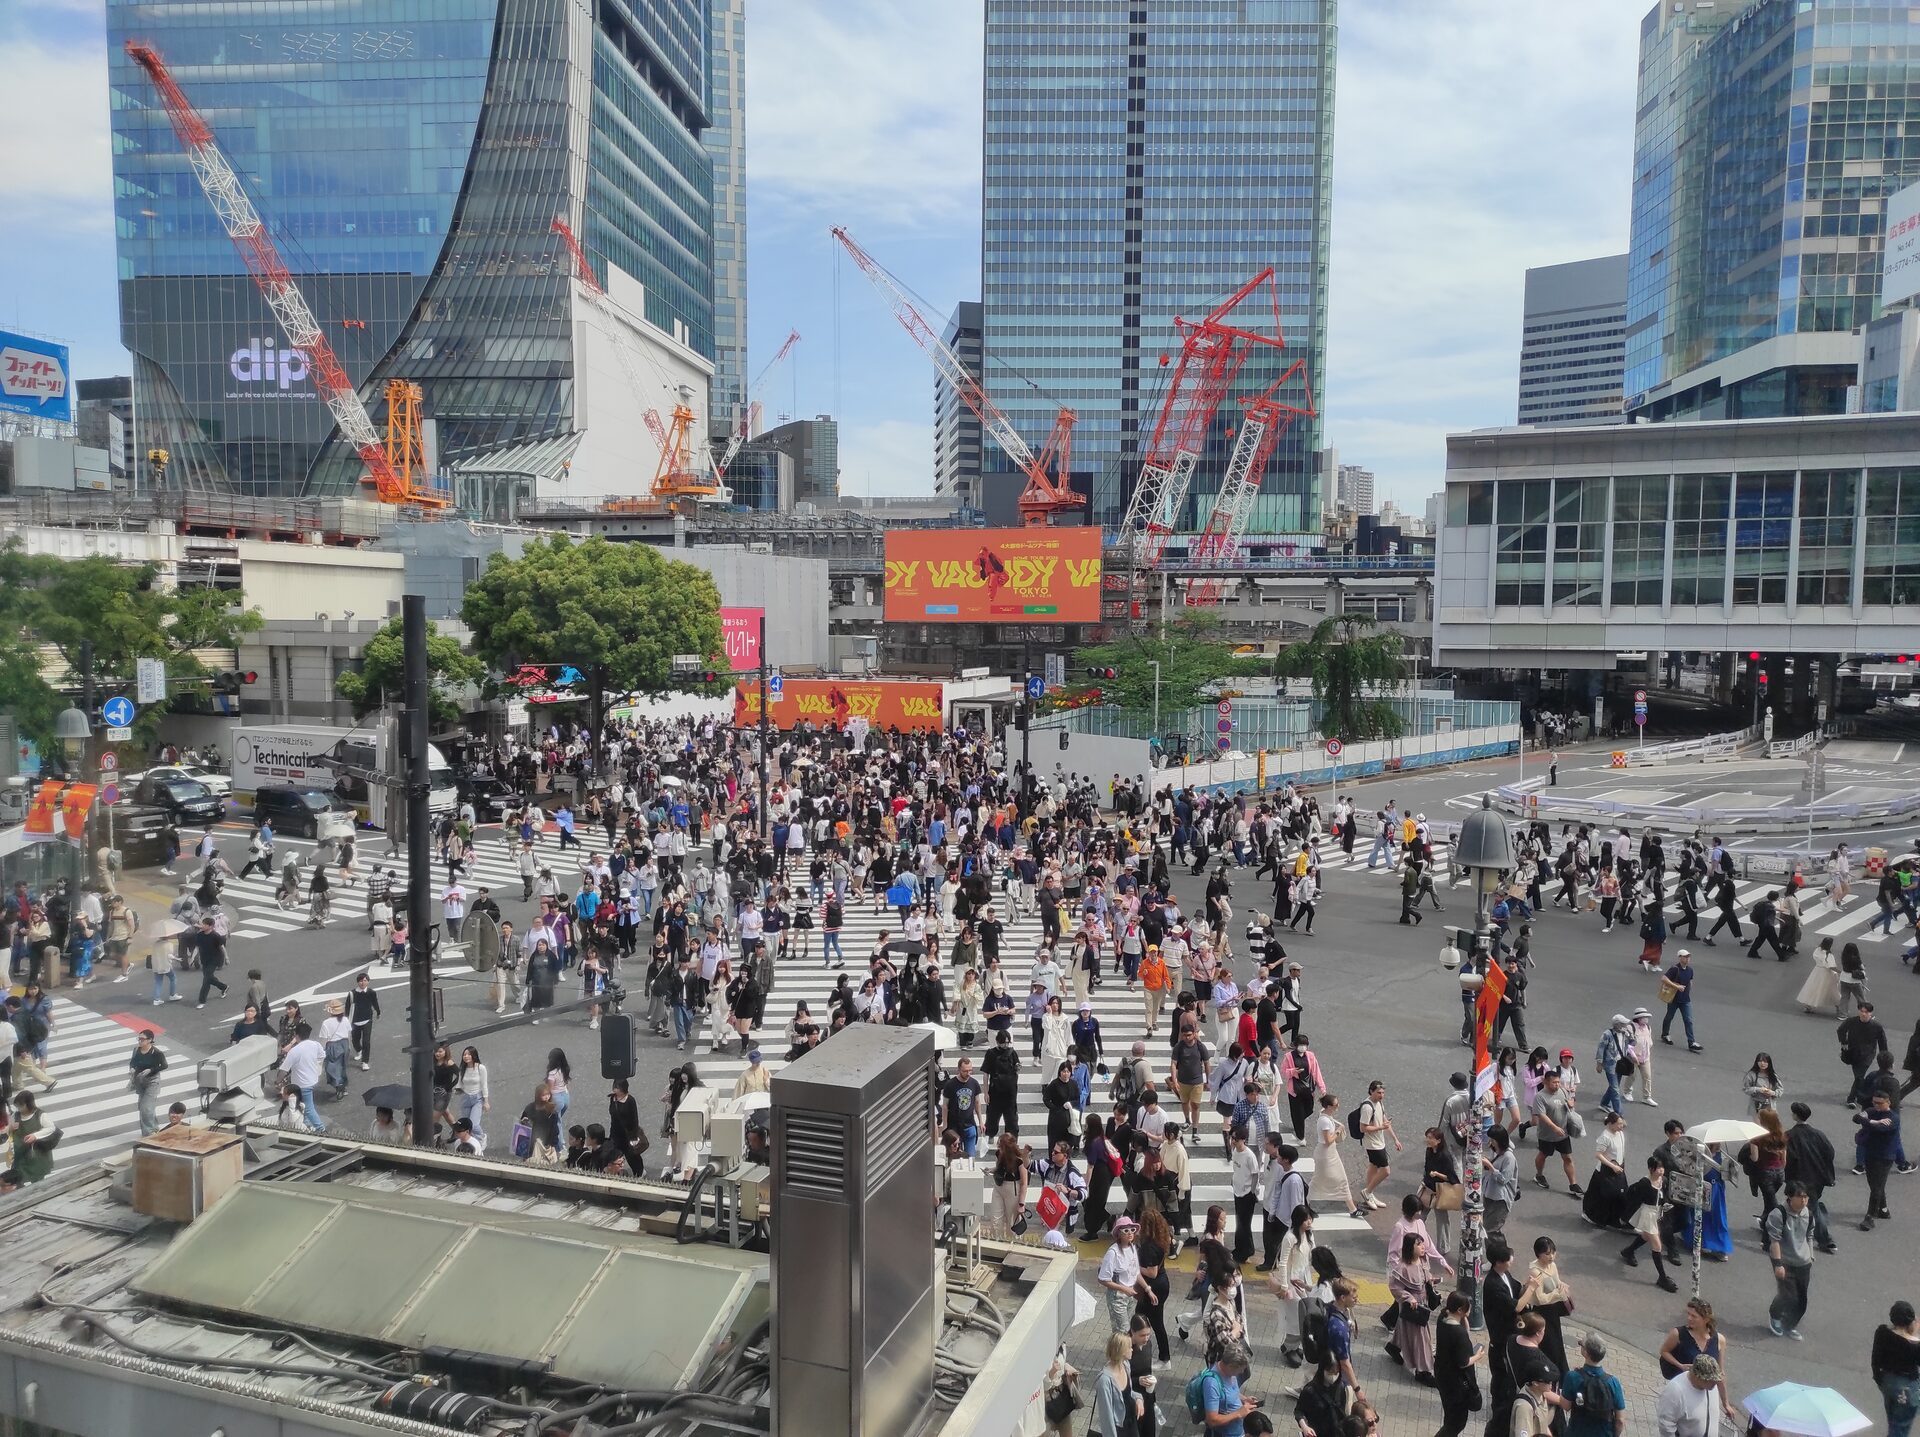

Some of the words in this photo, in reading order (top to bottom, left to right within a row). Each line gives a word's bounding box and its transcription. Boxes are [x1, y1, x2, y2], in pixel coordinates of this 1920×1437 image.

[5, 356, 56, 376] ファイト
[231, 337, 310, 389] dip
[1013, 587, 1049, 595] TOKYO
